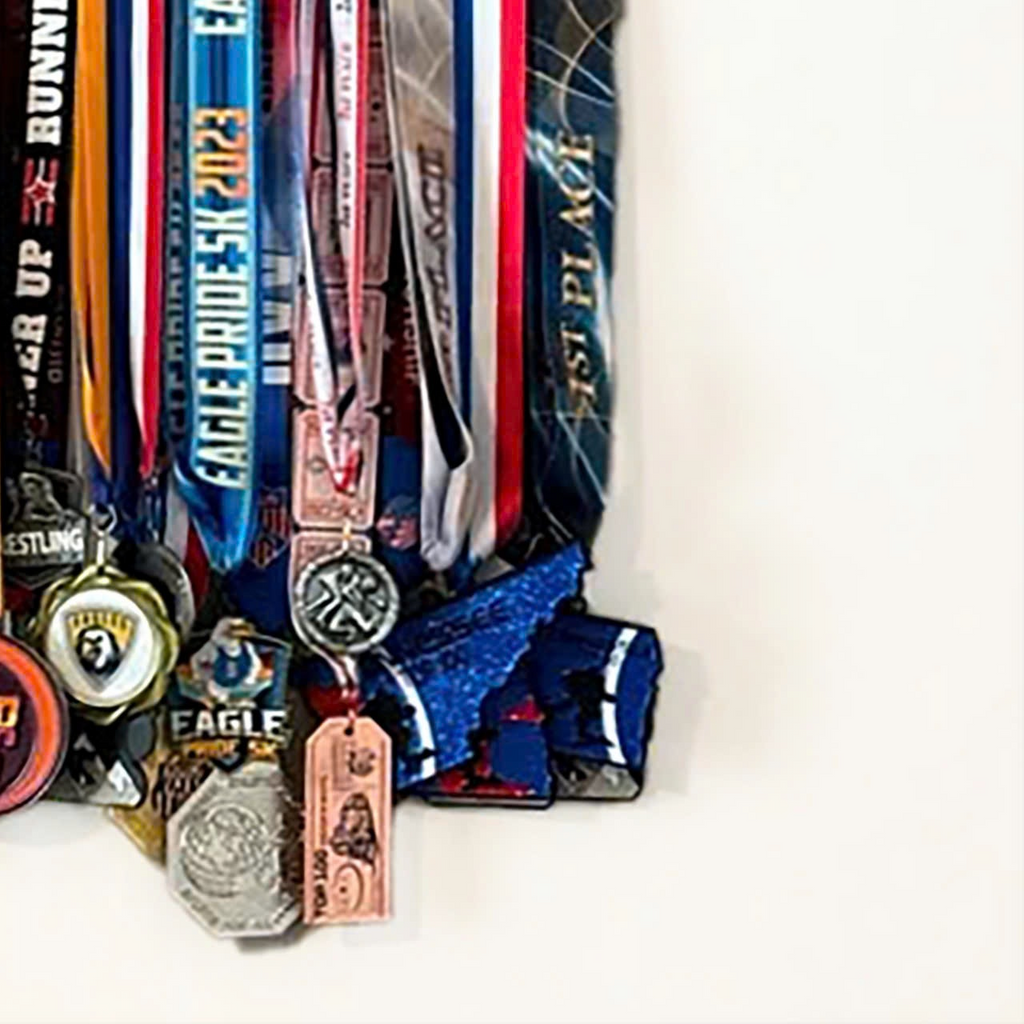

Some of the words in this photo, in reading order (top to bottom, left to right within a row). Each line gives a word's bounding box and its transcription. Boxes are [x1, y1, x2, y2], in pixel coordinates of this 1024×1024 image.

[194, 107, 250, 199] 2023
[15, 238, 53, 299] UP
[194, 263, 250, 369] PRIDE
[193, 377, 250, 490] EAGLE
[170, 707, 289, 741] EAGLE
